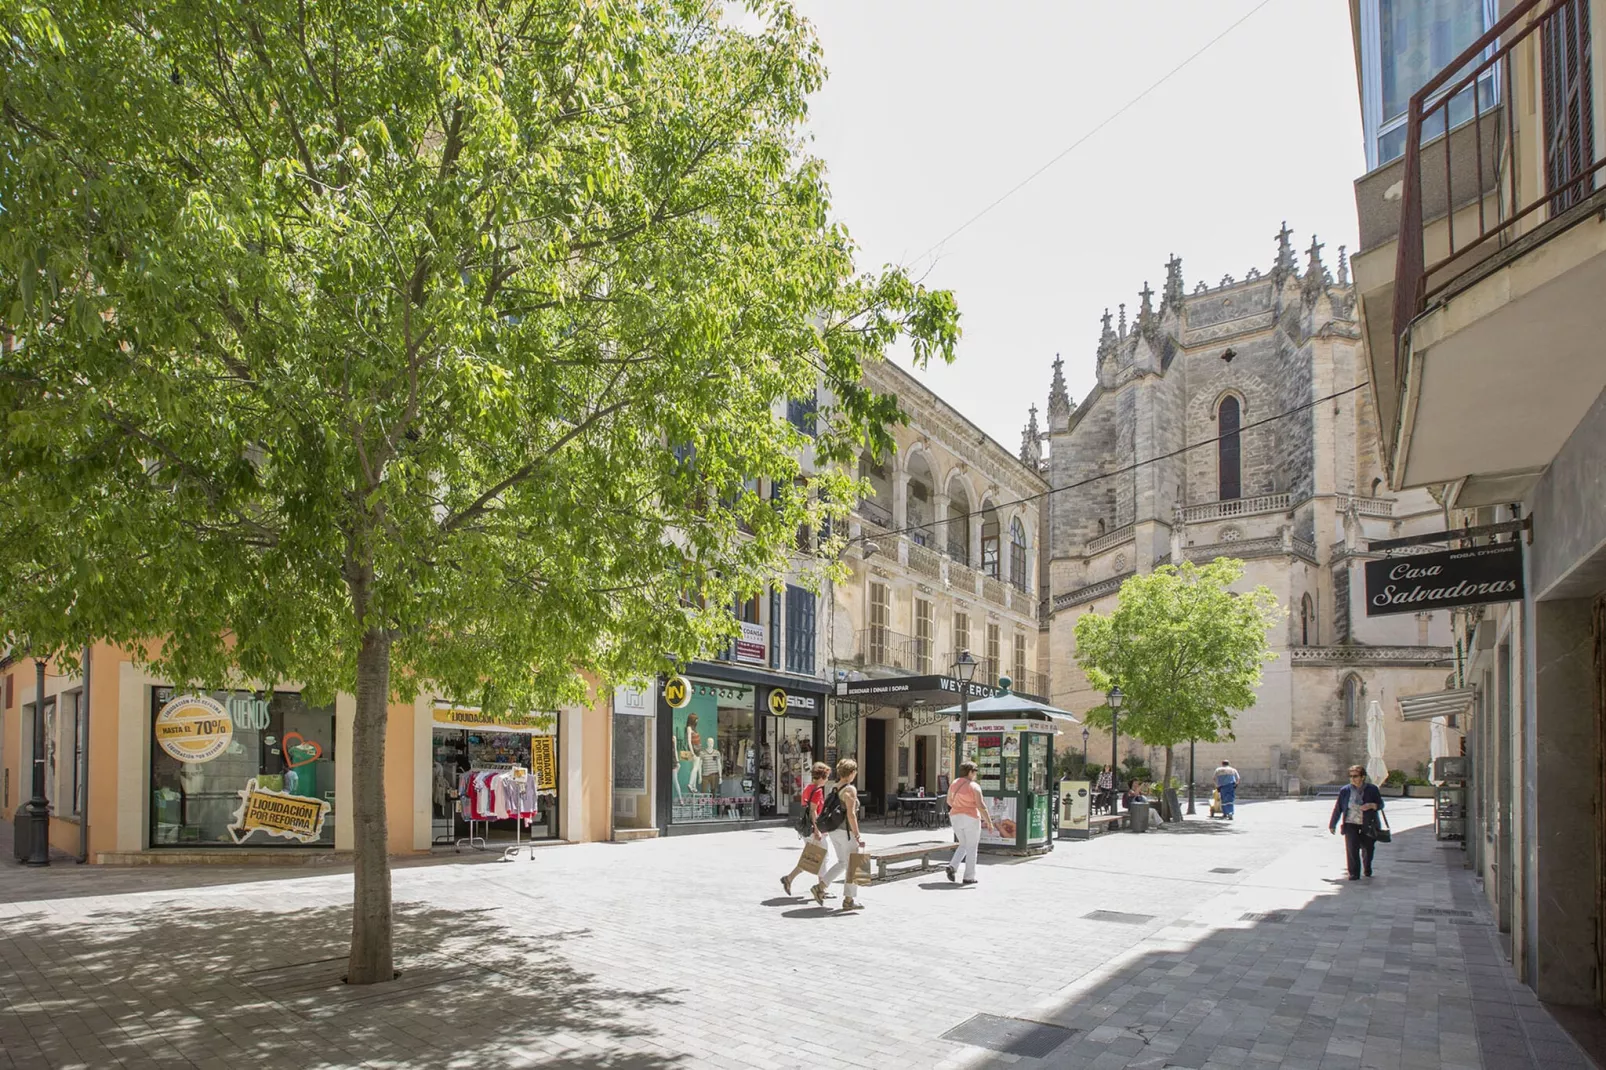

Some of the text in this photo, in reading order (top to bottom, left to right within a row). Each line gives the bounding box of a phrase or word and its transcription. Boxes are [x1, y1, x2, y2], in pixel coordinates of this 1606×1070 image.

[1389, 563, 1443, 580] Casa
[1373, 579, 1517, 606] Salvadoras
[162, 726, 183, 734] HASTA
[194, 720, 226, 735] 70%
[542, 740, 553, 785] LIQUIDACIÓN
[252, 798, 313, 819] LIQUIDACIÓN
[250, 809, 310, 829] POR REFORMA
